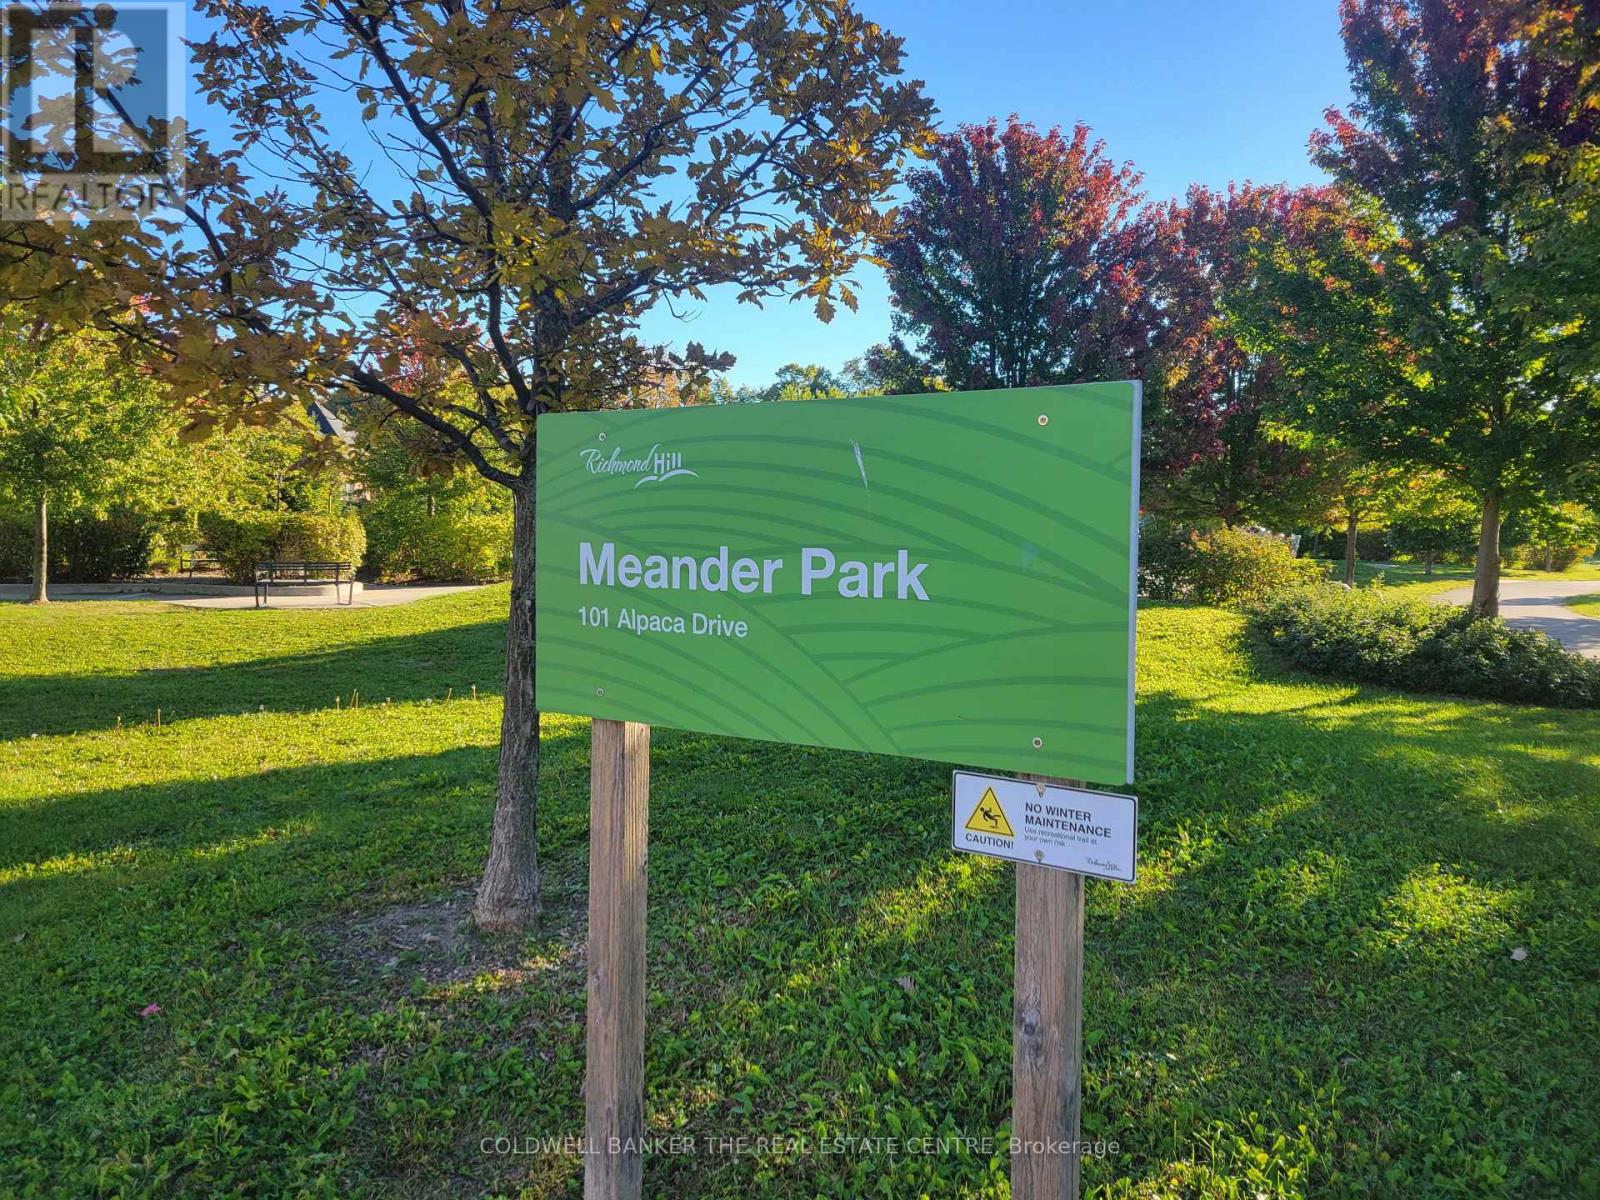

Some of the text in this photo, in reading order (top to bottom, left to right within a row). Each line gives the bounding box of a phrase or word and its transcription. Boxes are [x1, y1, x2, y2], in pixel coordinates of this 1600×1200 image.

[580, 443, 682, 475] Richmond Hill
[579, 542, 930, 601] Meander Park
[578, 606, 748, 638] 101 Alpaca Drive
[1025, 802, 1092, 822] NO WINTER
[1024, 826, 1037, 835] Use
[1038, 829, 1076, 841] recreational
[1025, 814, 1112, 839] MAINTENANCE
[965, 832, 1014, 850] CAUTION!
